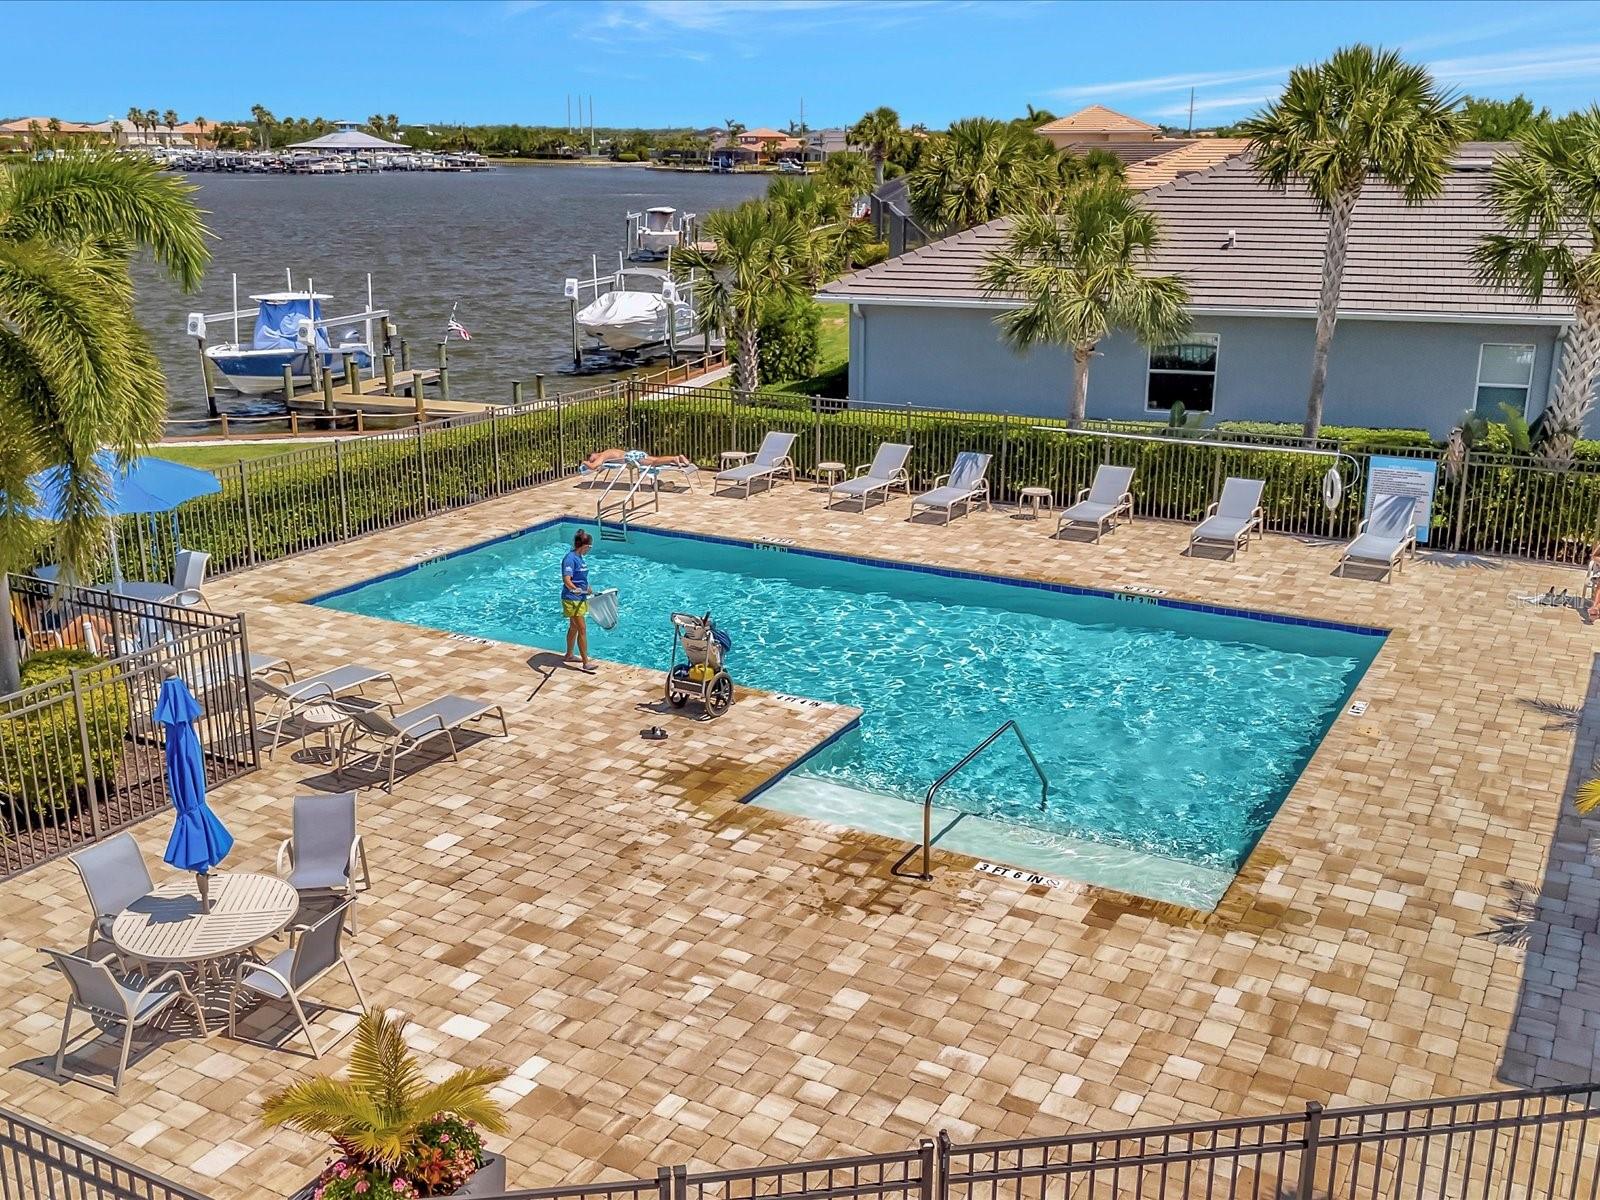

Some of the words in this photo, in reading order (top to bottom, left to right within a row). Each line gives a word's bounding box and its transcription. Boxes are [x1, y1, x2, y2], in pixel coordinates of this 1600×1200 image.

[1125, 595, 1136, 603] FT
[979, 863, 990, 871] 3
[992, 866, 1011, 876] FT
[1013, 871, 1024, 879] 6
[1026, 874, 1044, 884] IN
